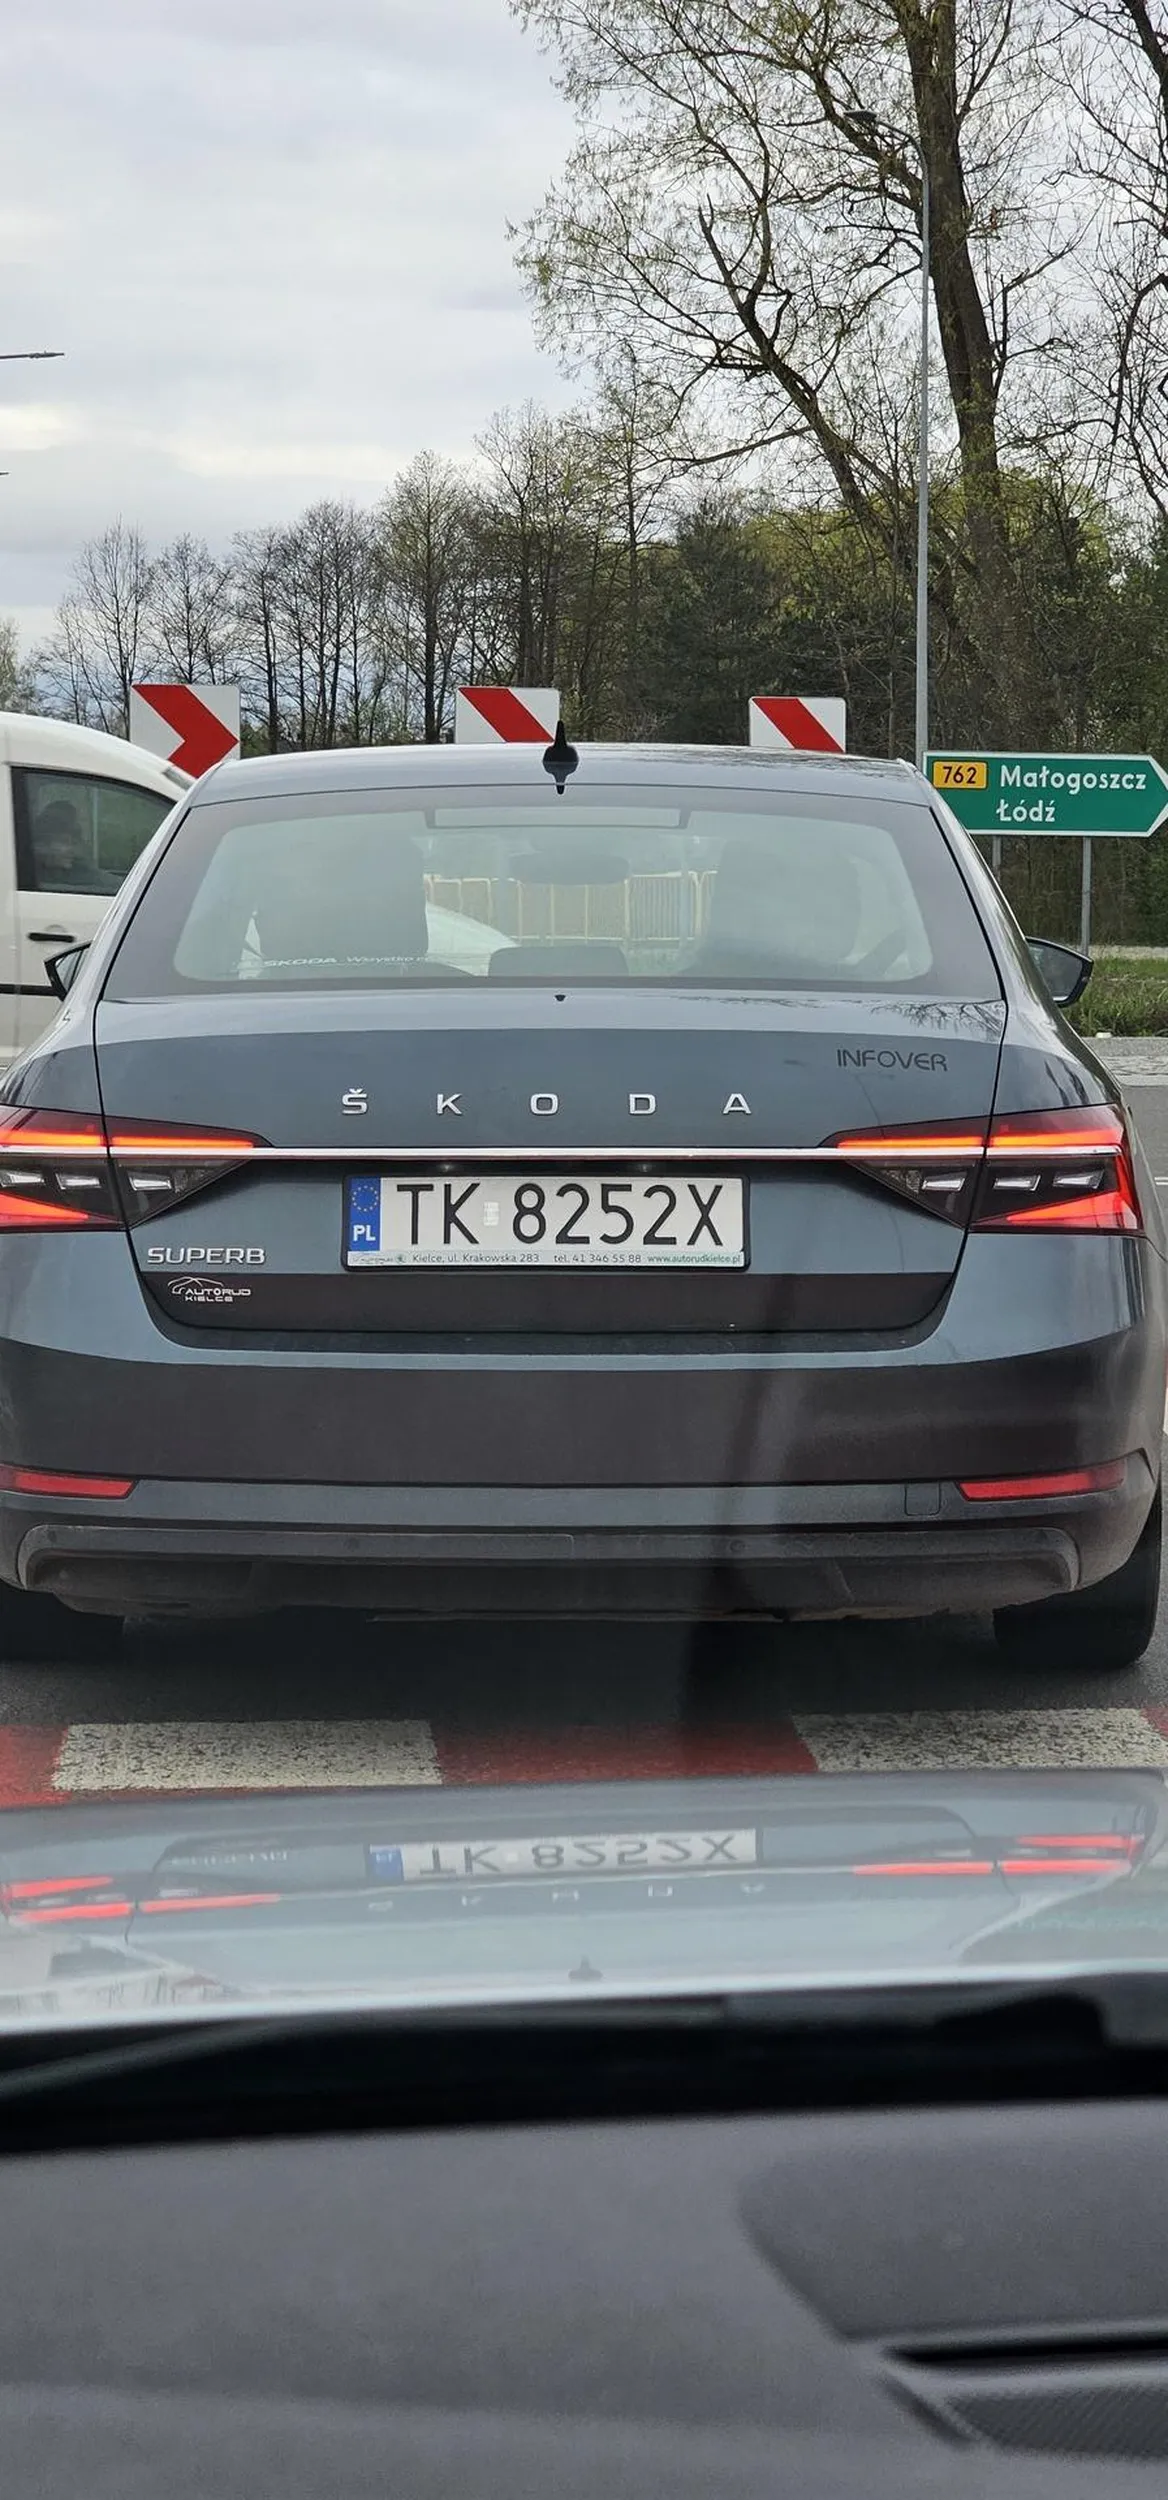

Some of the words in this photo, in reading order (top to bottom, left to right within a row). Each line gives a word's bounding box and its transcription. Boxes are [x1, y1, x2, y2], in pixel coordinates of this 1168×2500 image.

[942, 765, 977, 784] 762
[1000, 764, 1147, 795] Małogoszcz
[996, 799, 1056, 823] Łódź
[837, 1049, 948, 1072] INFOVER
[341, 1088, 752, 1116] ŠKODA
[396, 1183, 480, 1246] TK
[512, 1182, 723, 1246] 8252X
[352, 1225, 377, 1242] PL
[147, 1246, 266, 1265] SUPERB
[412, 1253, 445, 1264] Kielce,
[463, 1253, 517, 1263] Krakowska
[520, 1254, 540, 1263] 283
[572, 1254, 586, 1263] 41
[589, 1254, 609, 1263] 346
[612, 1254, 625, 1263] 55
[628, 1254, 642, 1263] 88
[647, 1253, 741, 1265] www.autorudkielce.pl
[185, 1287, 252, 1296] AUTORUD
